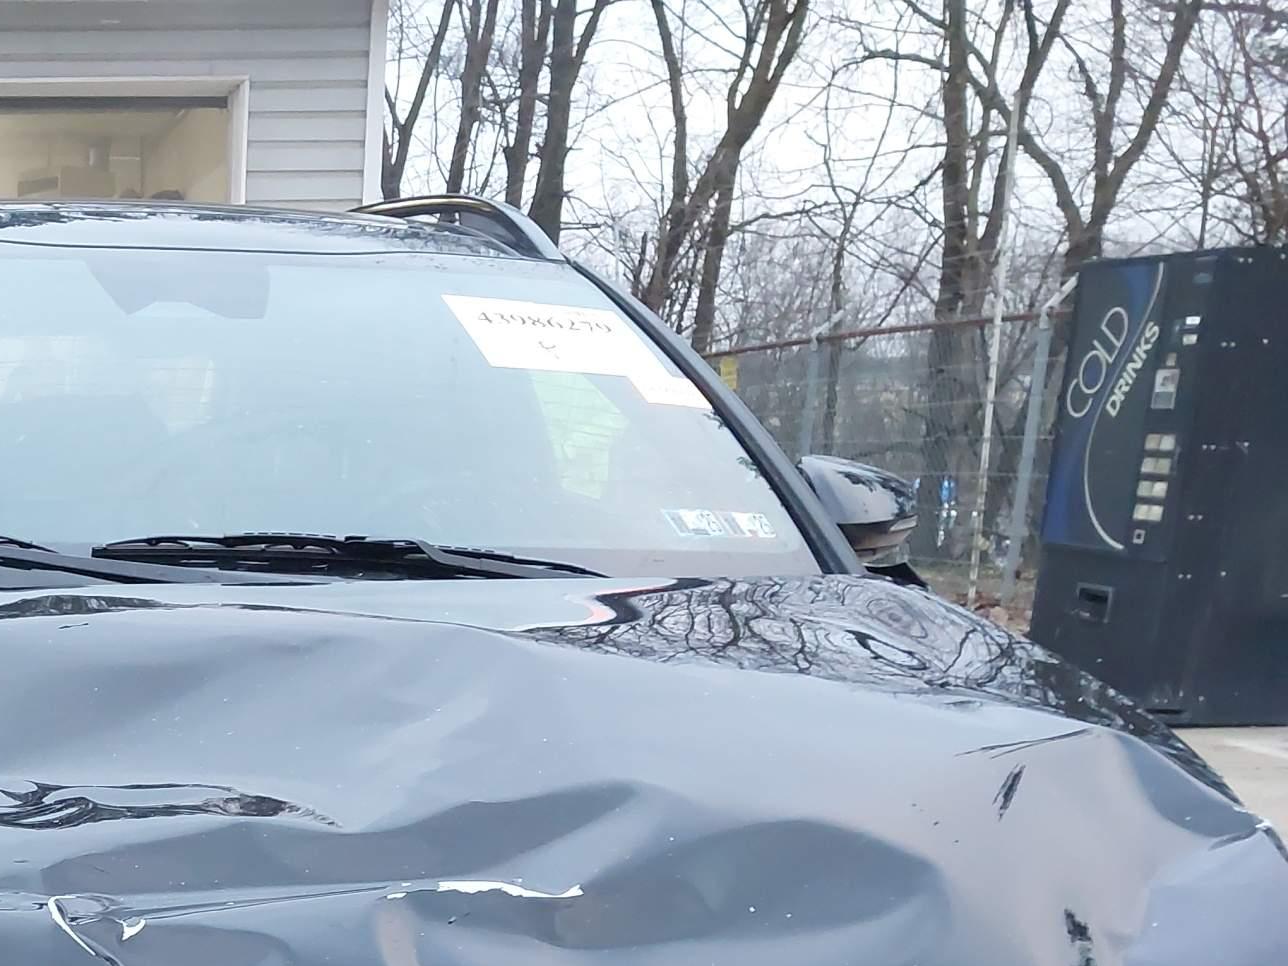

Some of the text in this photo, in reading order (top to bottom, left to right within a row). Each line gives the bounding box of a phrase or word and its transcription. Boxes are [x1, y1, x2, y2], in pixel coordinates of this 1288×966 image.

[477, 311, 613, 333] 43986279
[1067, 306, 1129, 418] COLD
[1106, 321, 1160, 418] DRINKS
